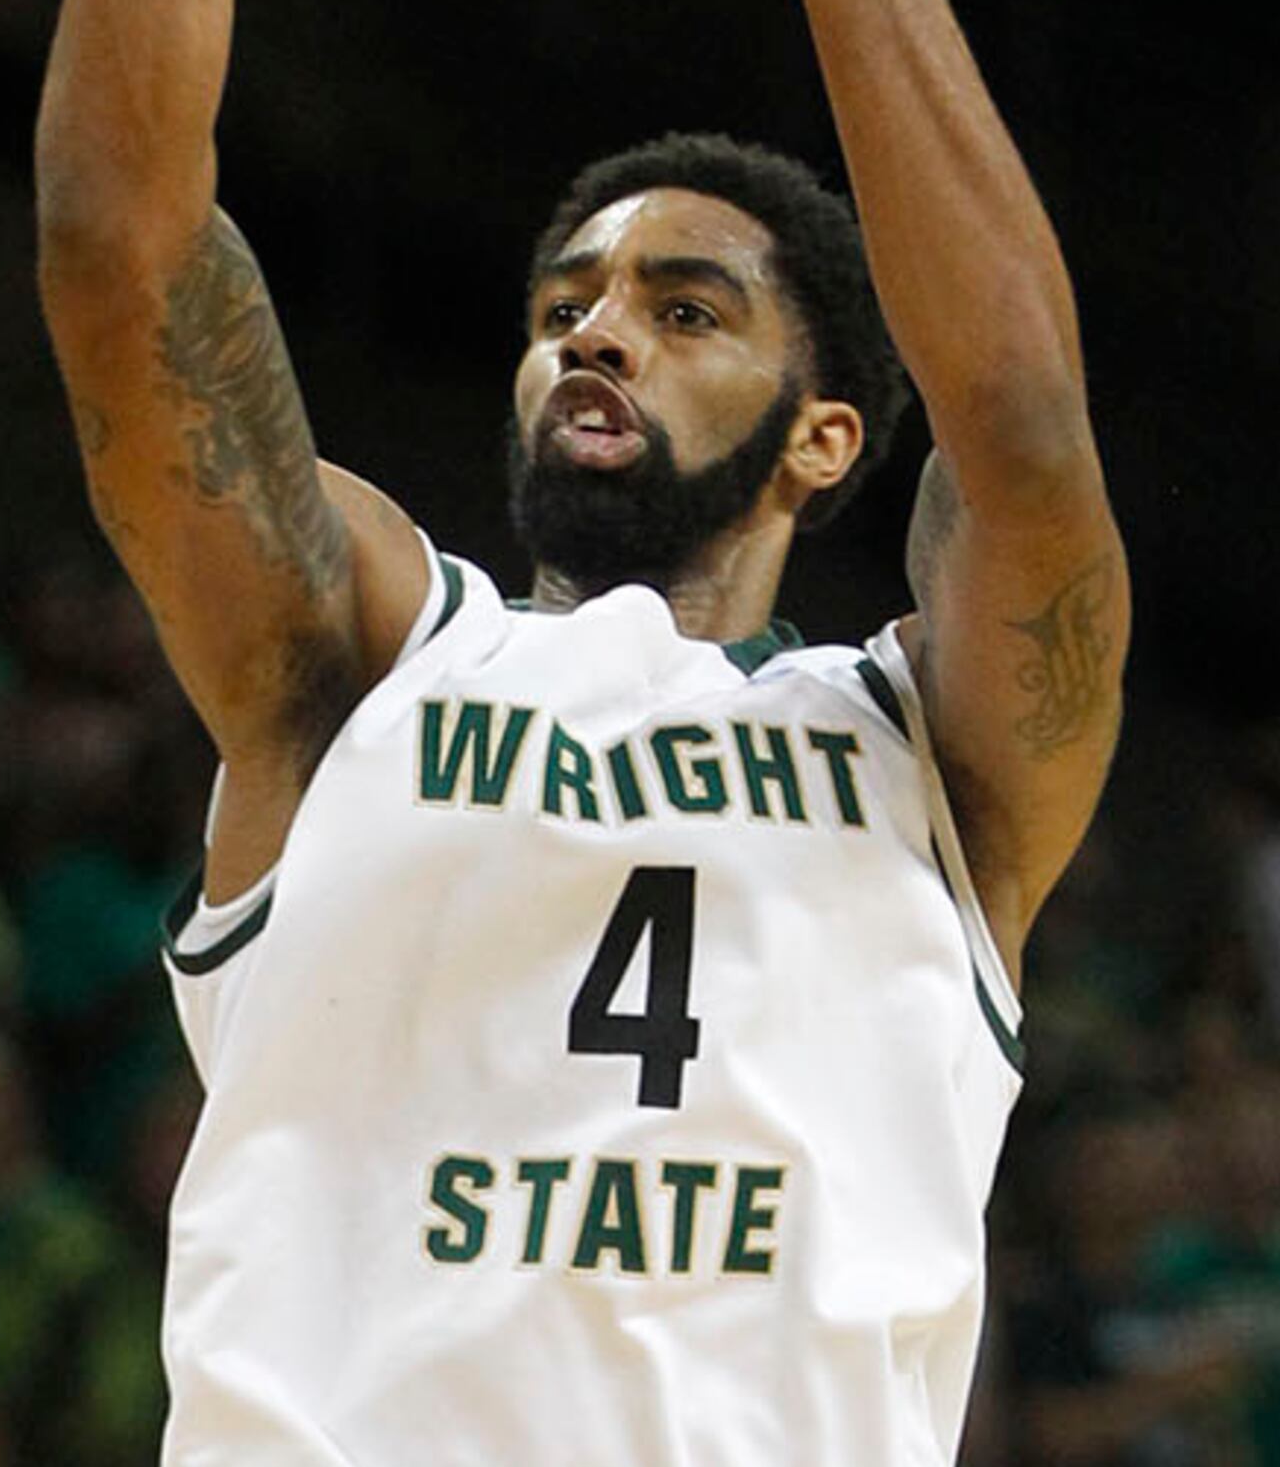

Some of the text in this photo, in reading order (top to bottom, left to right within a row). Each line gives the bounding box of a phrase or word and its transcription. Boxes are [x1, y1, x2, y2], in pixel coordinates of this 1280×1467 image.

[415, 697, 870, 831] WRIGHT
[568, 866, 701, 1110] 4
[424, 1149, 789, 1279] STATE
